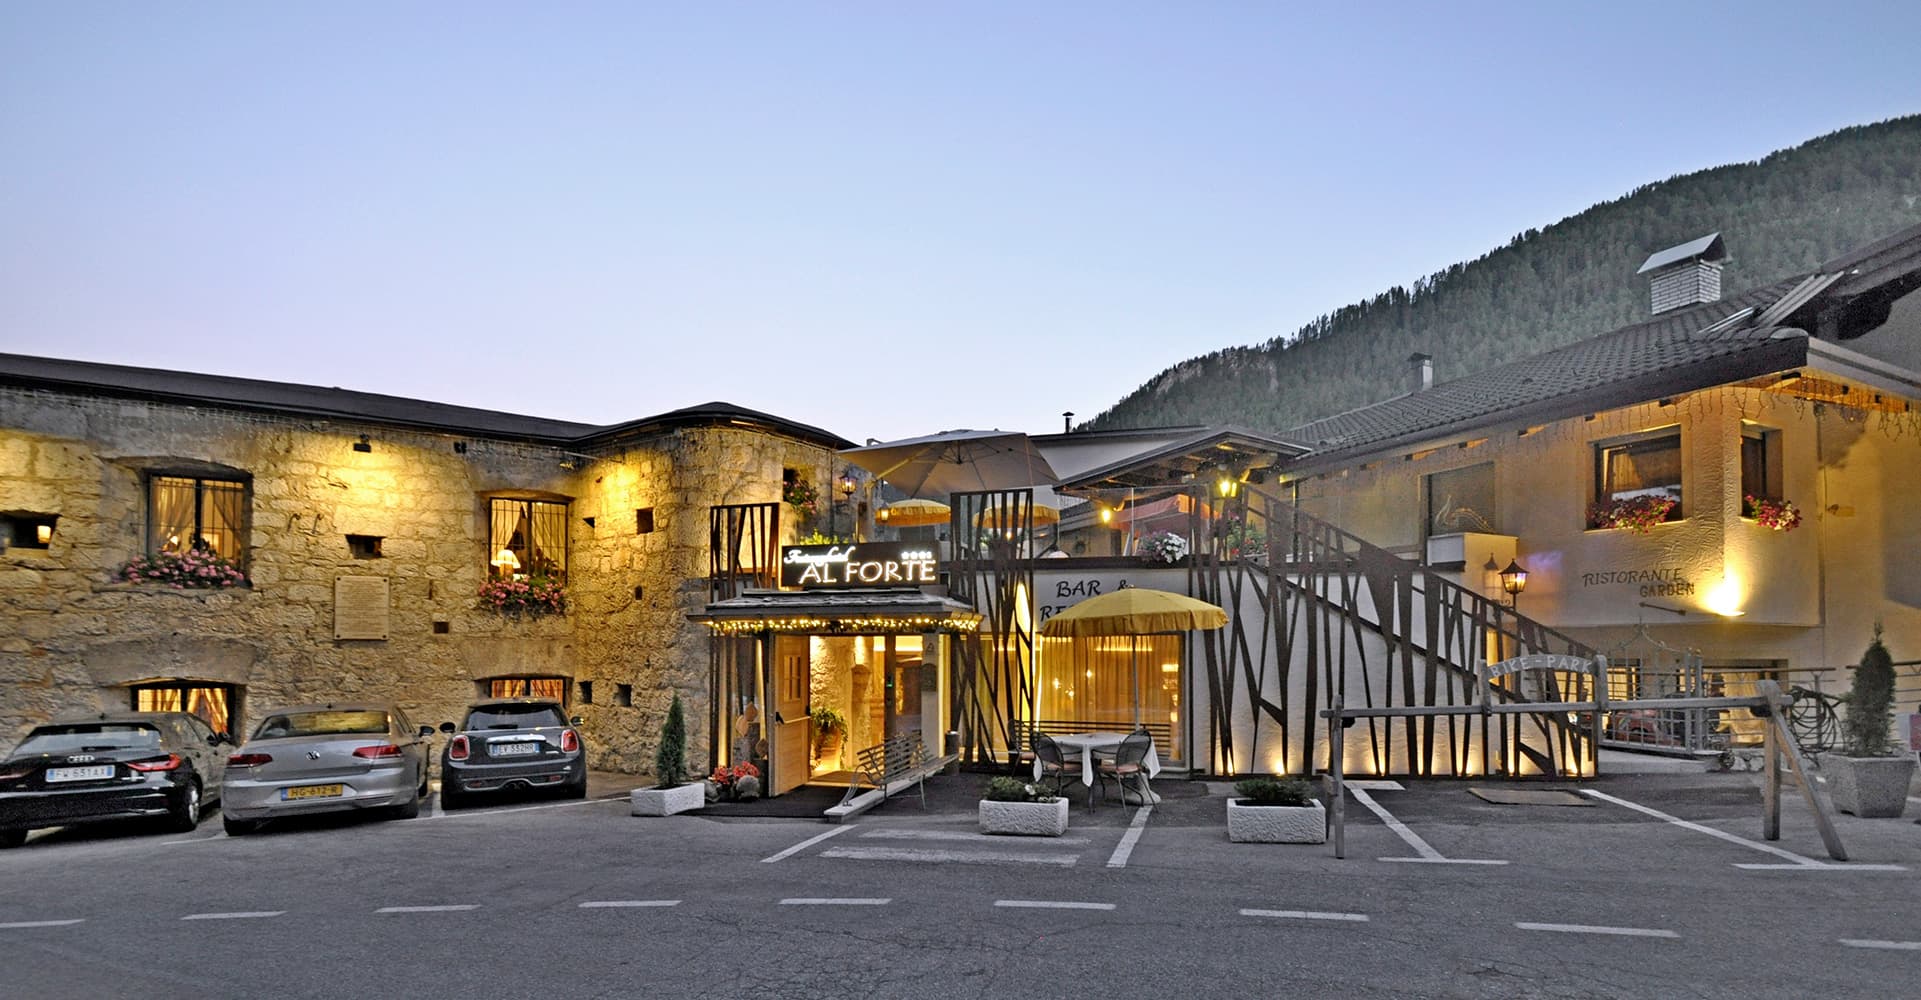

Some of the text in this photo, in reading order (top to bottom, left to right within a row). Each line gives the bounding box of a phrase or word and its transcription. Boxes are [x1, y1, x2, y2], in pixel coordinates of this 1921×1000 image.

[798, 560, 936, 584] AL FORTE
[1582, 568, 1682, 587] RISTORANTE
[1056, 580, 1101, 598] BAR
[1640, 582, 1695, 598] GARDEN
